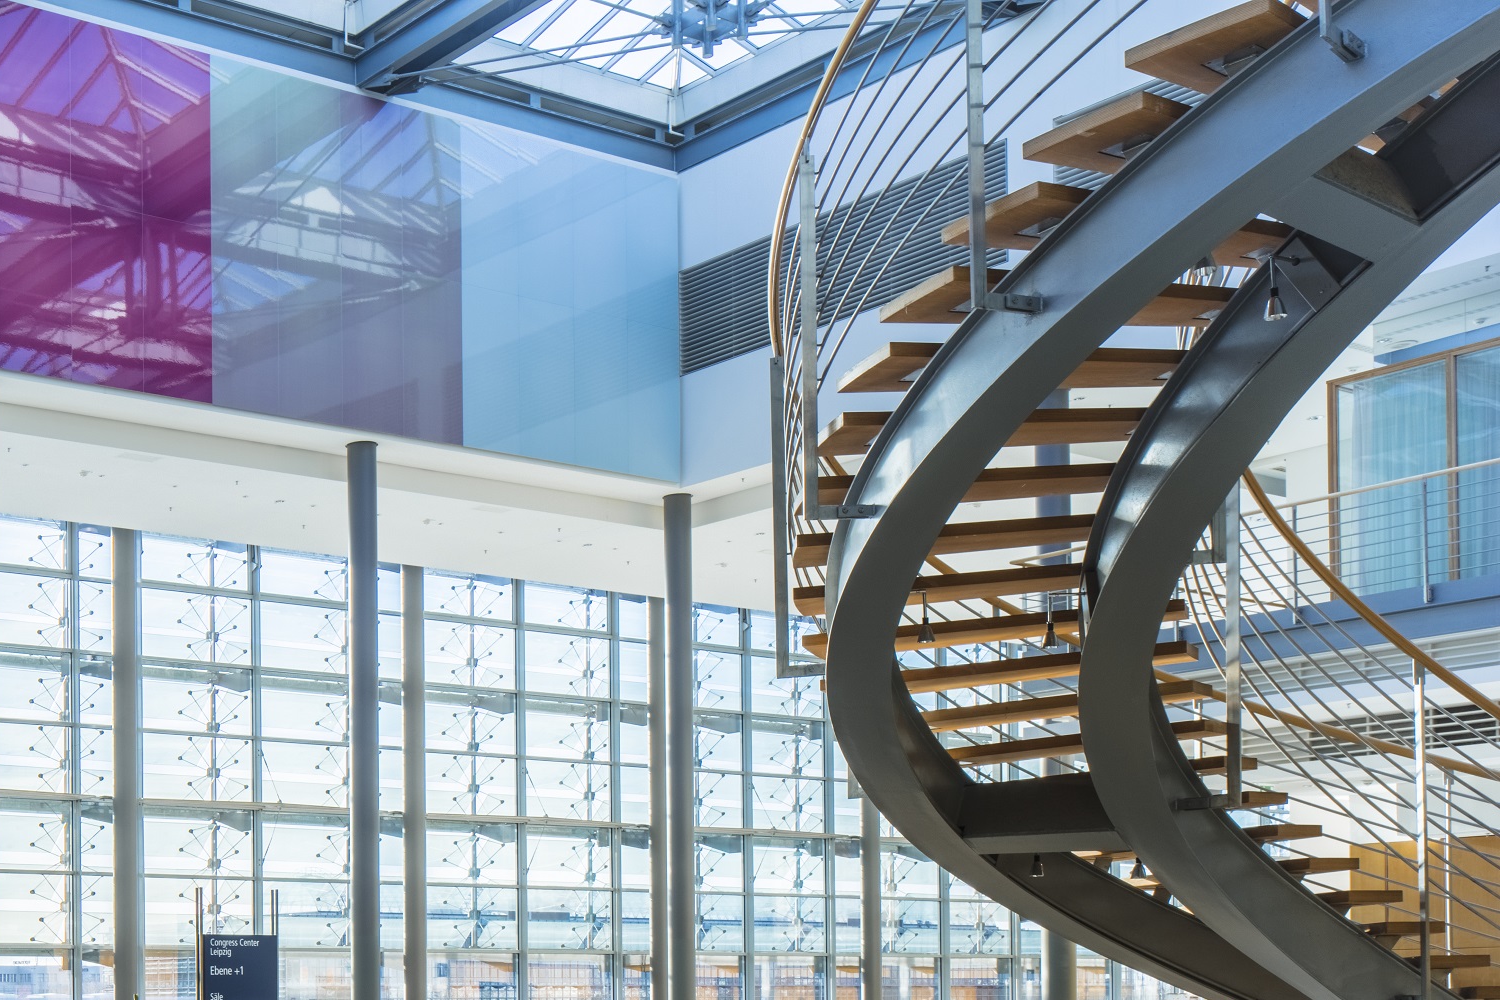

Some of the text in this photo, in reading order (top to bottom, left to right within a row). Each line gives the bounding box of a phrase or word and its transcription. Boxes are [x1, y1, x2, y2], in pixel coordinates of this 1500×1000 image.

[210, 938, 259, 948] Congress Center
[210, 947, 232, 957] Leipzig
[210, 966, 244, 976] Ebene +1
[210, 992, 223, 1000] Säle
